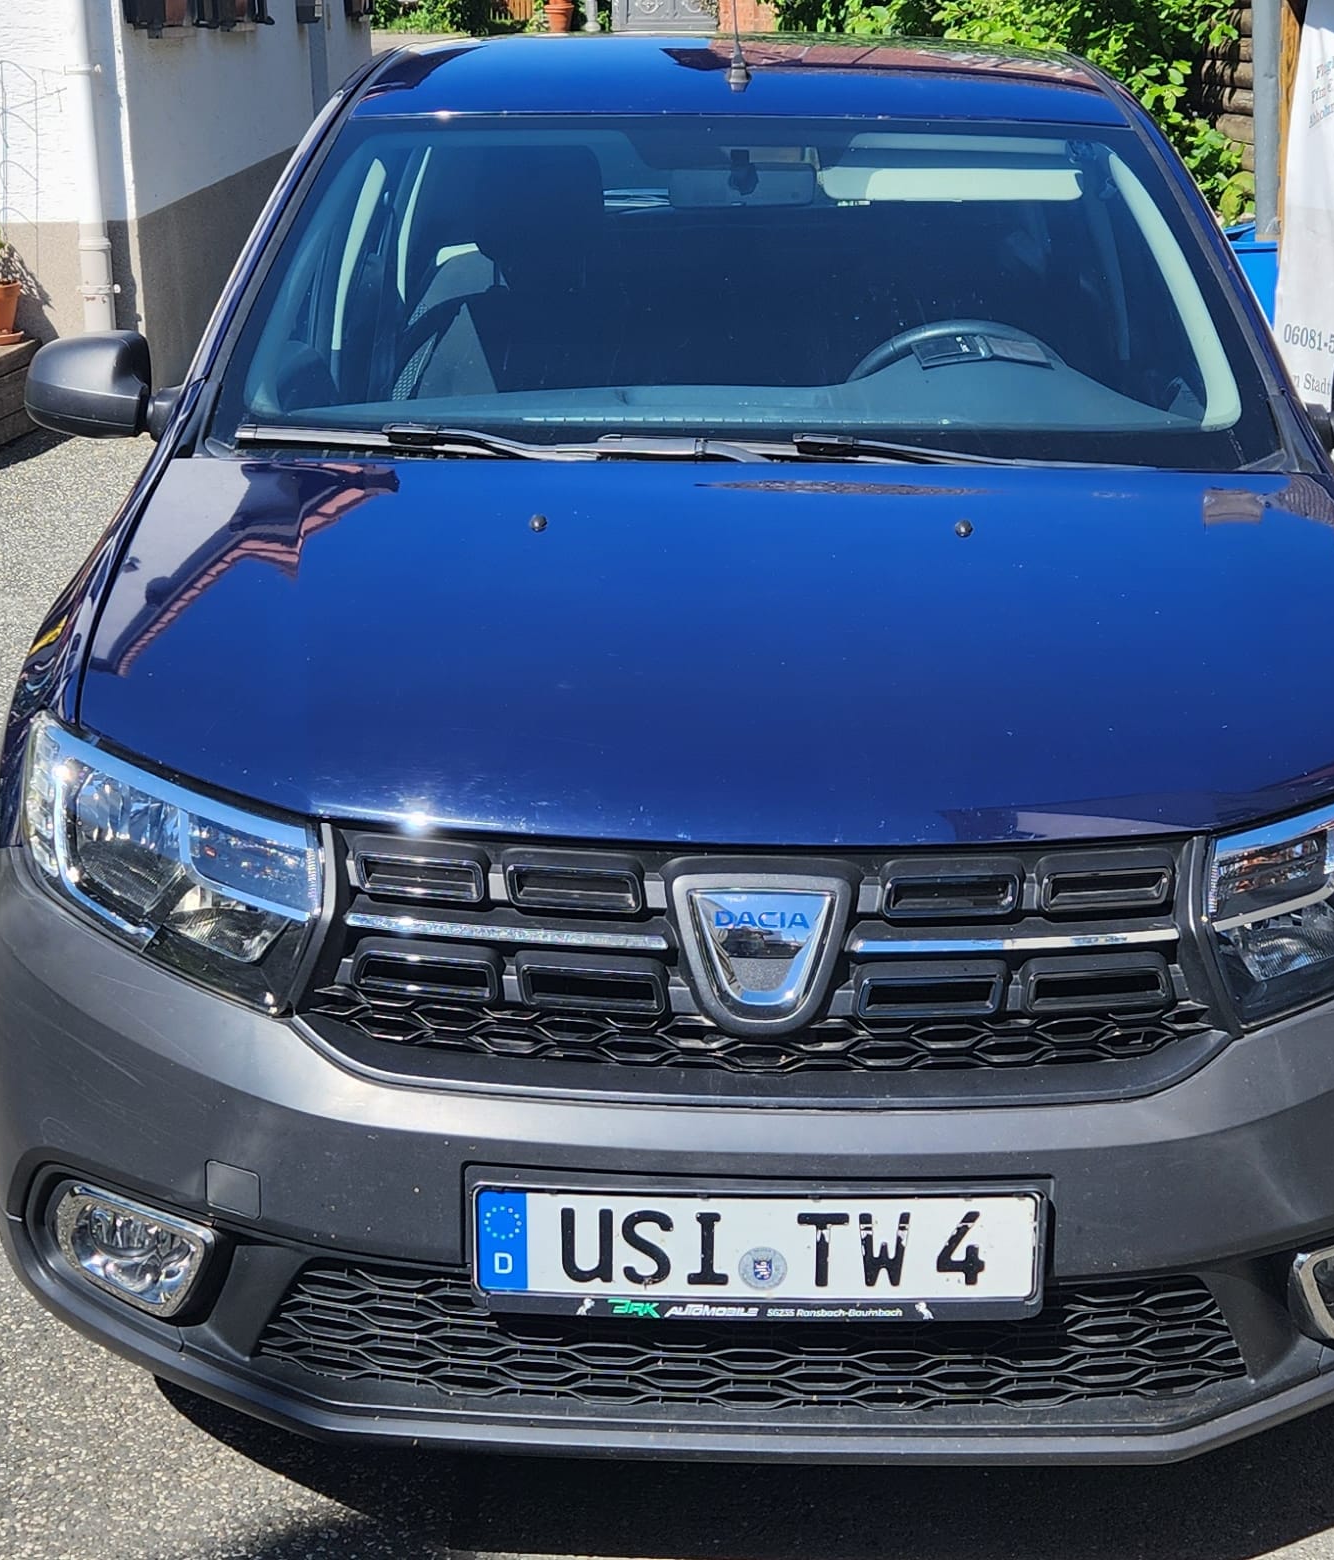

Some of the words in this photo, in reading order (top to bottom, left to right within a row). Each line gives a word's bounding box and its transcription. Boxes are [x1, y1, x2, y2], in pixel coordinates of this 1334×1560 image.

[714, 910, 810, 929] DACIA
[560, 1207, 729, 1286] USI
[797, 1211, 910, 1288] TW
[935, 1210, 986, 1287] 4
[494, 1252, 514, 1274] D
[664, 1303, 759, 1318] AUTOMOBILE
[796, 1308, 903, 1318] Ransbach-Baumbach
